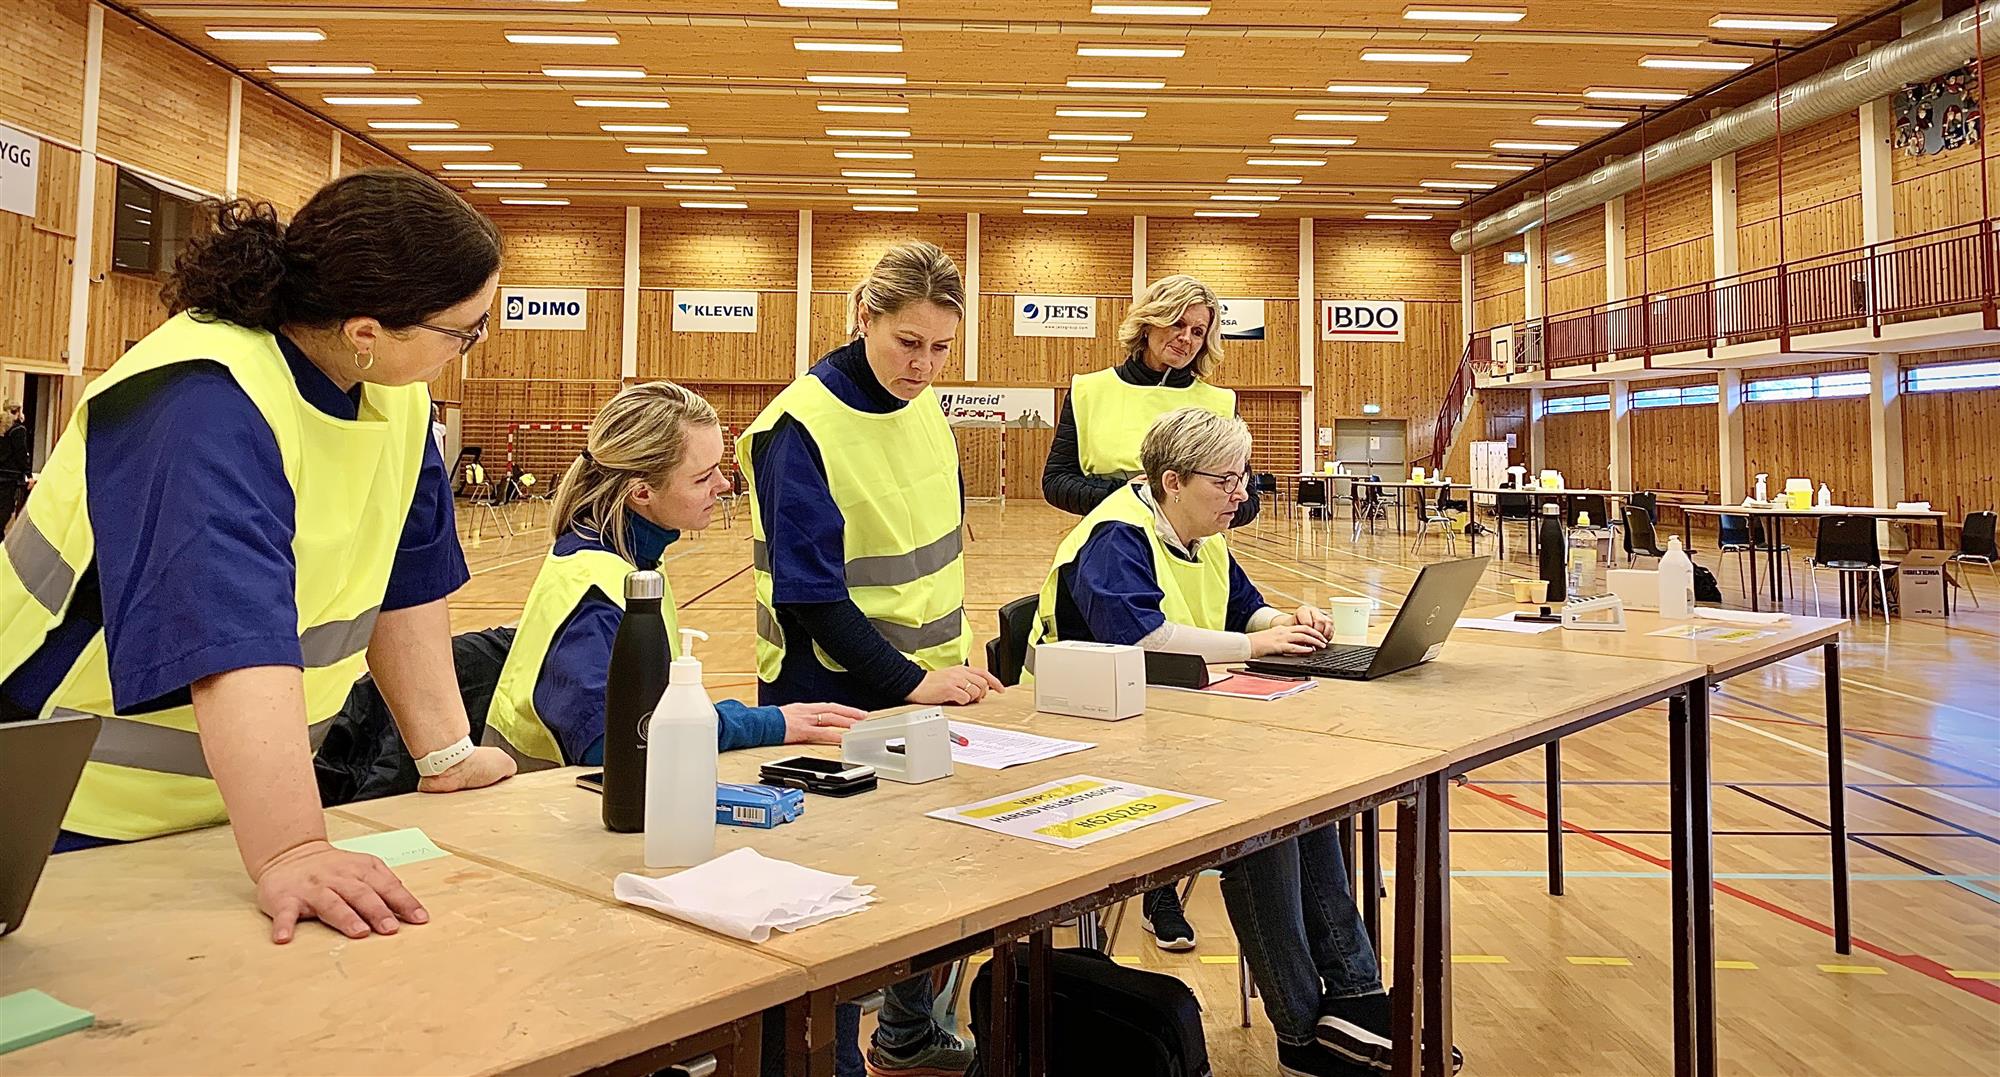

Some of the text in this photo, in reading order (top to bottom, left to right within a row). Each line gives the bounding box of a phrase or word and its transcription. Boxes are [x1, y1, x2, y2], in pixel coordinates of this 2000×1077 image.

[528, 302, 580, 316] DIMO
[694, 306, 753, 316] KLEVEN
[1042, 305, 1089, 324] JETS
[1335, 306, 1398, 328] BDO
[956, 394, 1000, 405] Hareid
[954, 407, 994, 419] Group
[990, 808, 1041, 823] HAREID
[1075, 803, 1157, 828] #620243
